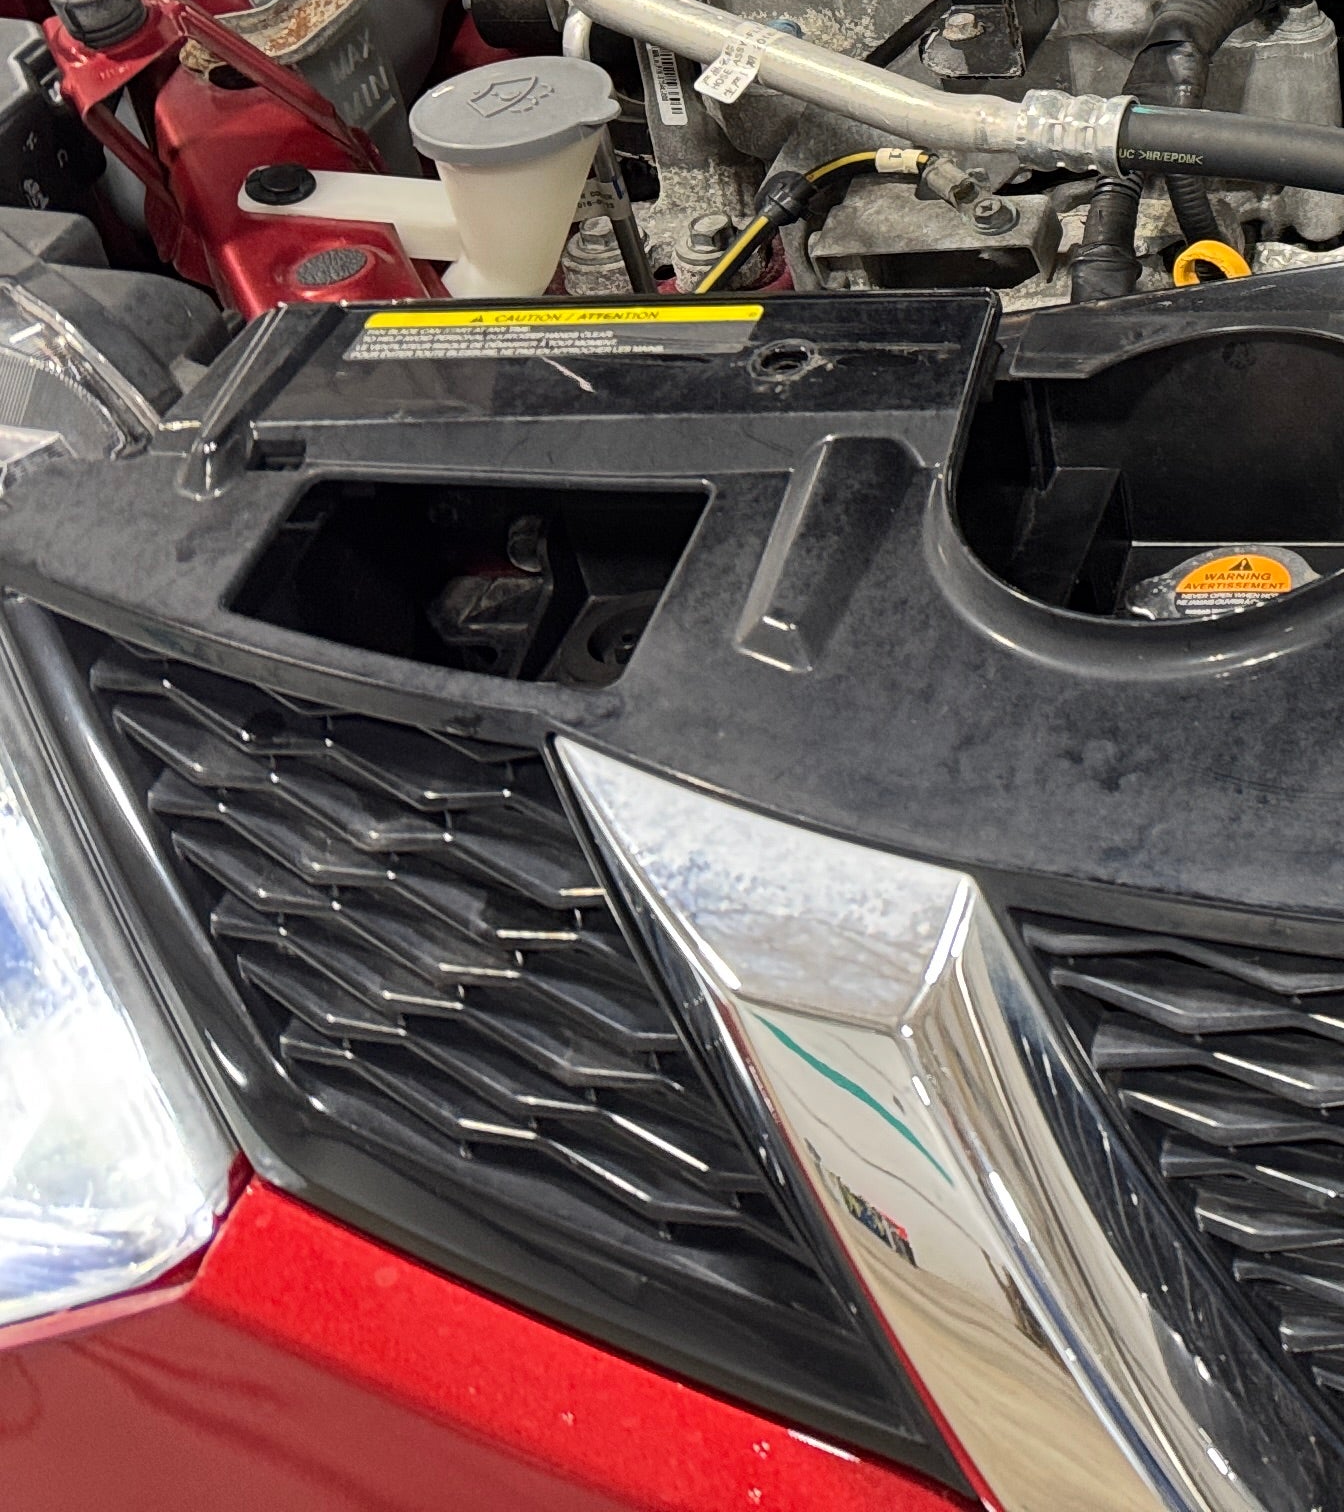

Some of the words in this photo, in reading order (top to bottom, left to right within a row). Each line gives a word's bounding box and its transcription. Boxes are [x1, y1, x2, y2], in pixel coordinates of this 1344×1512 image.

[712, 66, 733, 90] HOSE
[494, 313, 561, 323] CAUTION
[579, 311, 660, 321] ATTENTION
[1204, 572, 1272, 581] WARNING
[1183, 582, 1286, 591] AVERTISSEMENT
